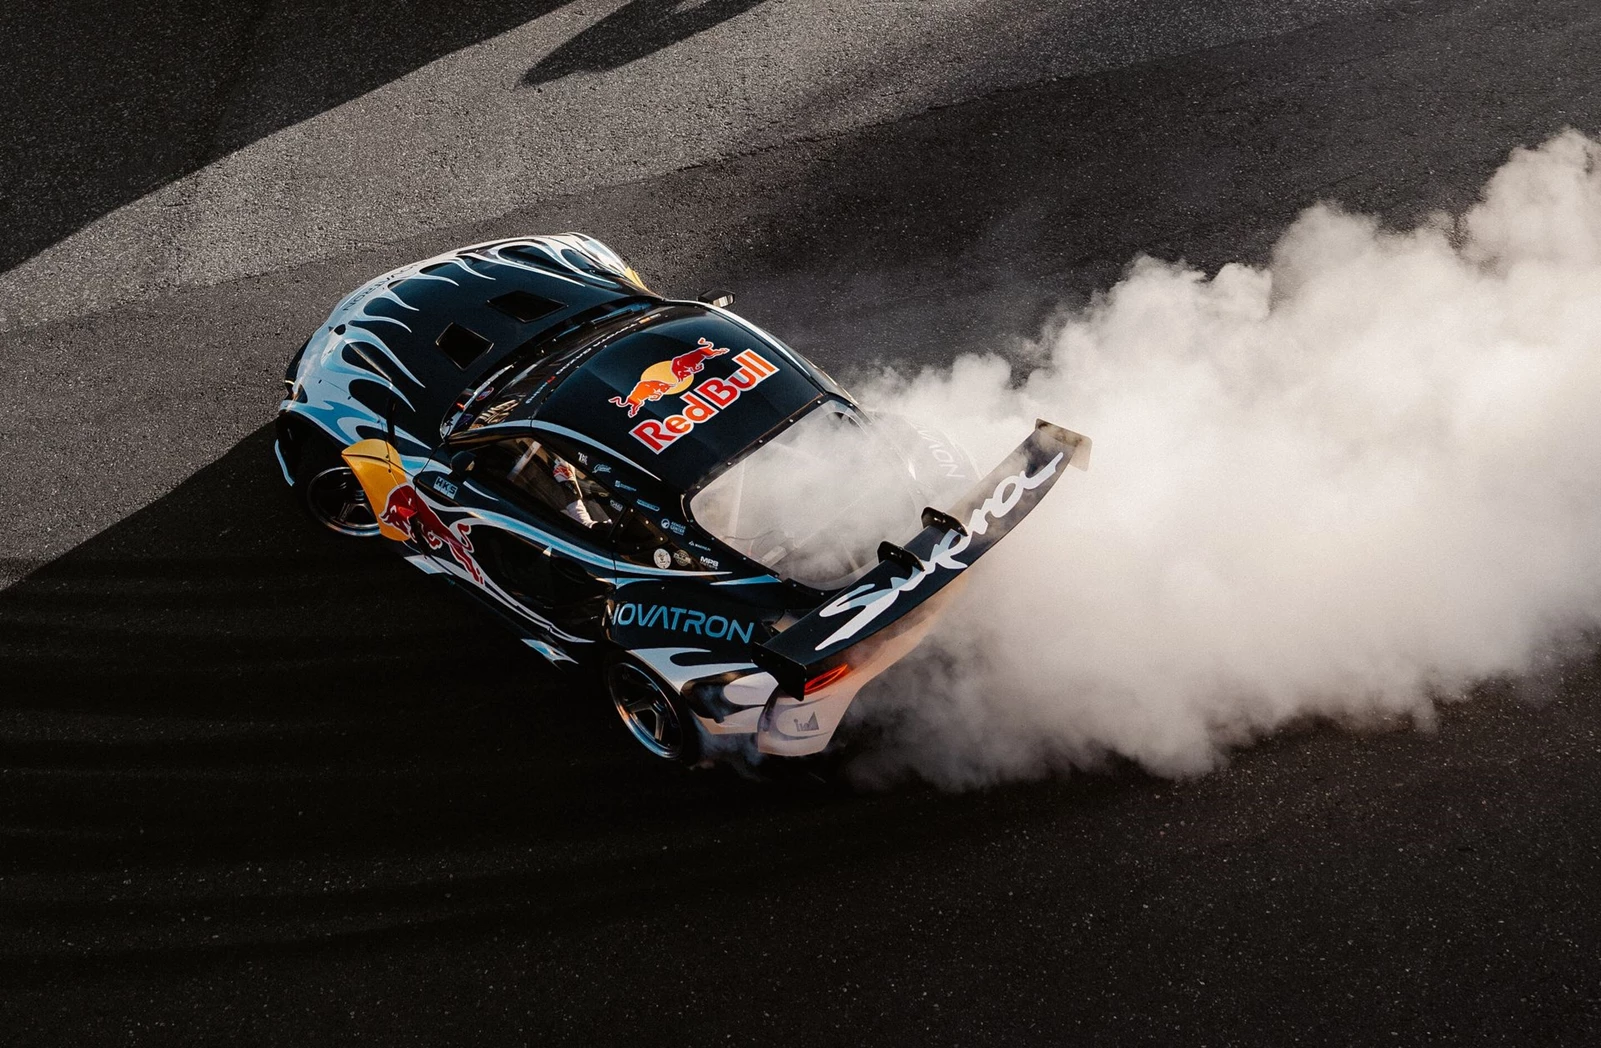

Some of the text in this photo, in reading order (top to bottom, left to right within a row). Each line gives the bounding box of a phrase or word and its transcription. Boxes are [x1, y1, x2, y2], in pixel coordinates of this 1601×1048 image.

[630, 391, 719, 454] Red
[695, 349, 779, 409] Bull
[435, 477, 457, 495] HKS
[815, 452, 1064, 651] Supra
